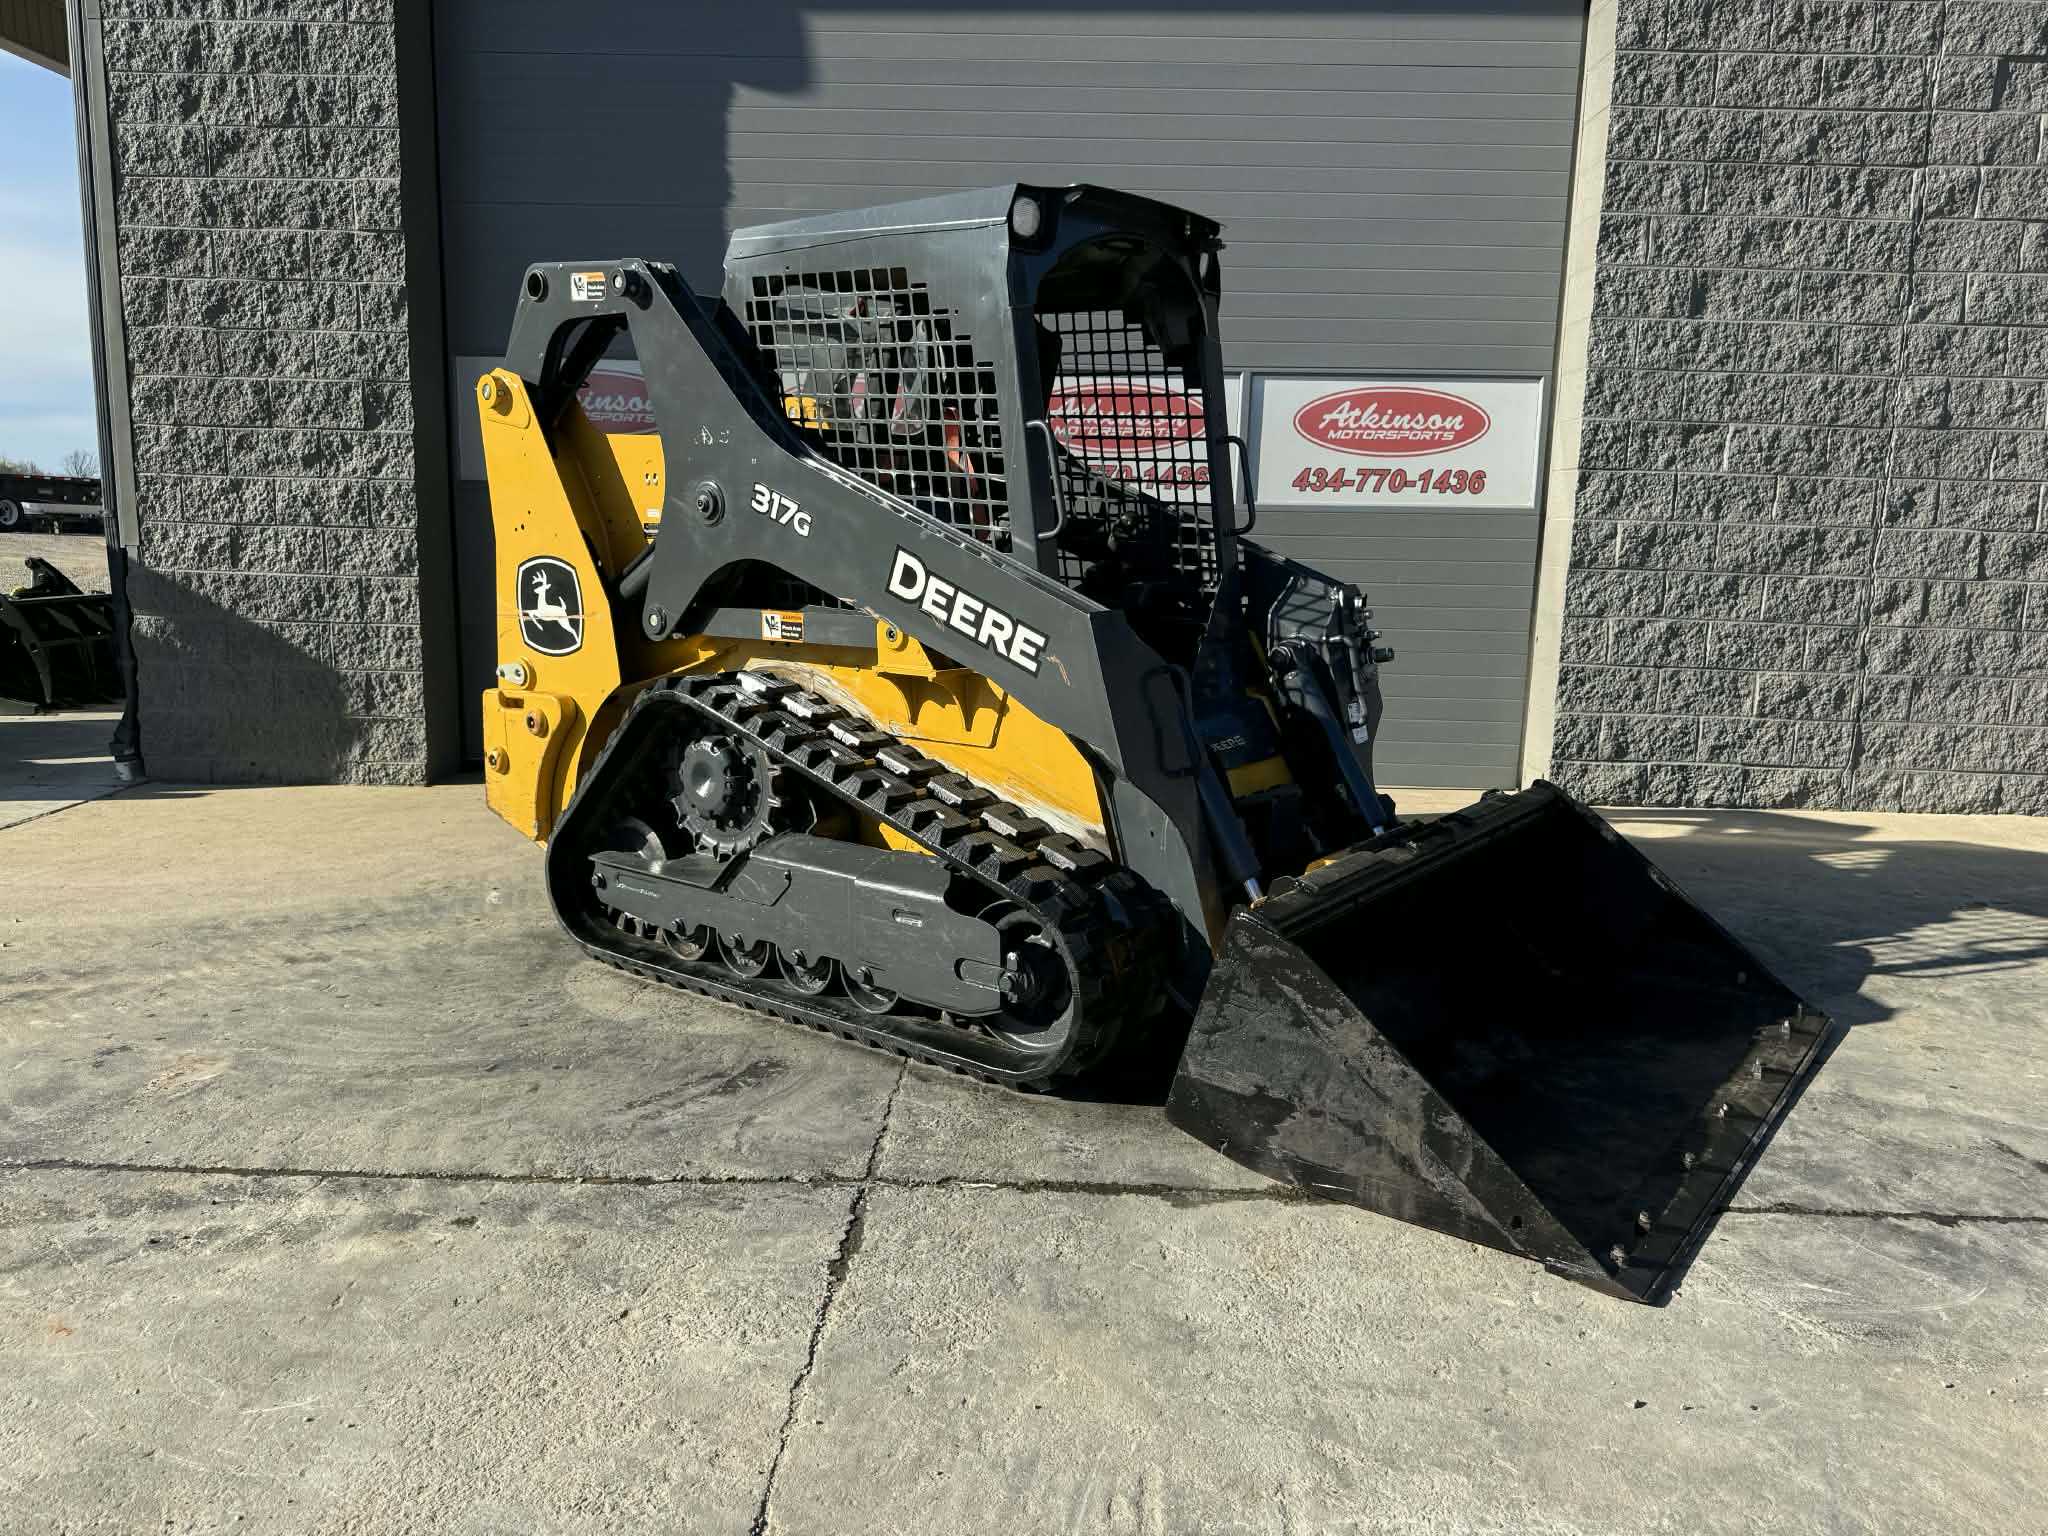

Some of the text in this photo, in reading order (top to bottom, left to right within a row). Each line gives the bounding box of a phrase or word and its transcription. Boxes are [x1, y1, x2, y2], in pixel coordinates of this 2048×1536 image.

[585, 411, 655, 423] SPORTS
[1318, 400, 1465, 431] Atkinson
[1327, 429, 1456, 441] MOTORSPORTS
[1291, 467, 1487, 494] 434-770-1436
[751, 483, 812, 538] 317G
[888, 548, 1047, 674] DEERE
